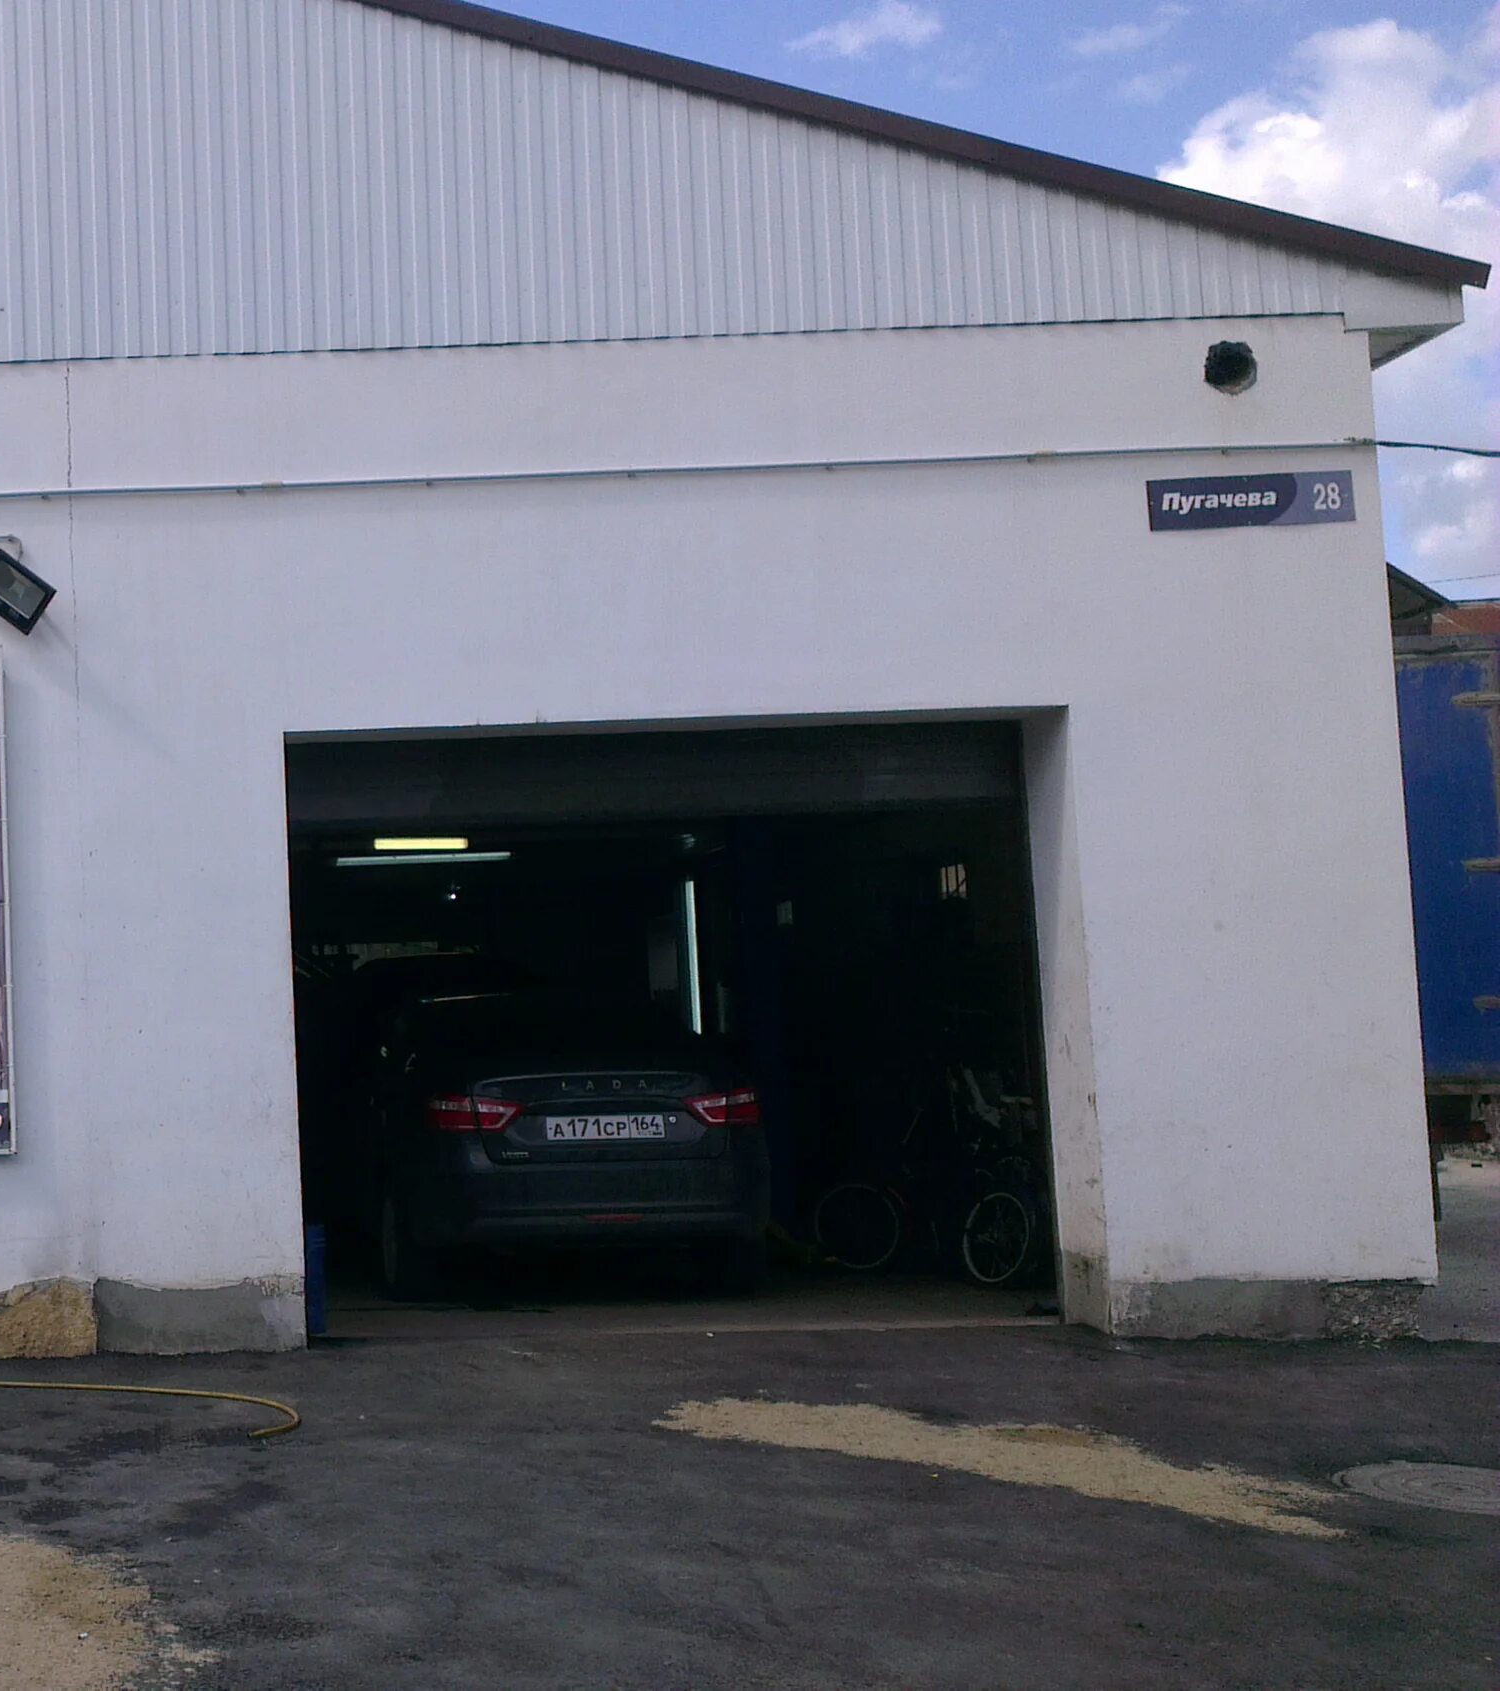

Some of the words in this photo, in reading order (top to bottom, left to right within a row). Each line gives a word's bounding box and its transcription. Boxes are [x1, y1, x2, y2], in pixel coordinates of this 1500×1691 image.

[1161, 491, 1277, 515] Пугачева
[1313, 482, 1341, 510] 28
[561, 1078, 647, 1092] LADA
[631, 1116, 660, 1131] 164
